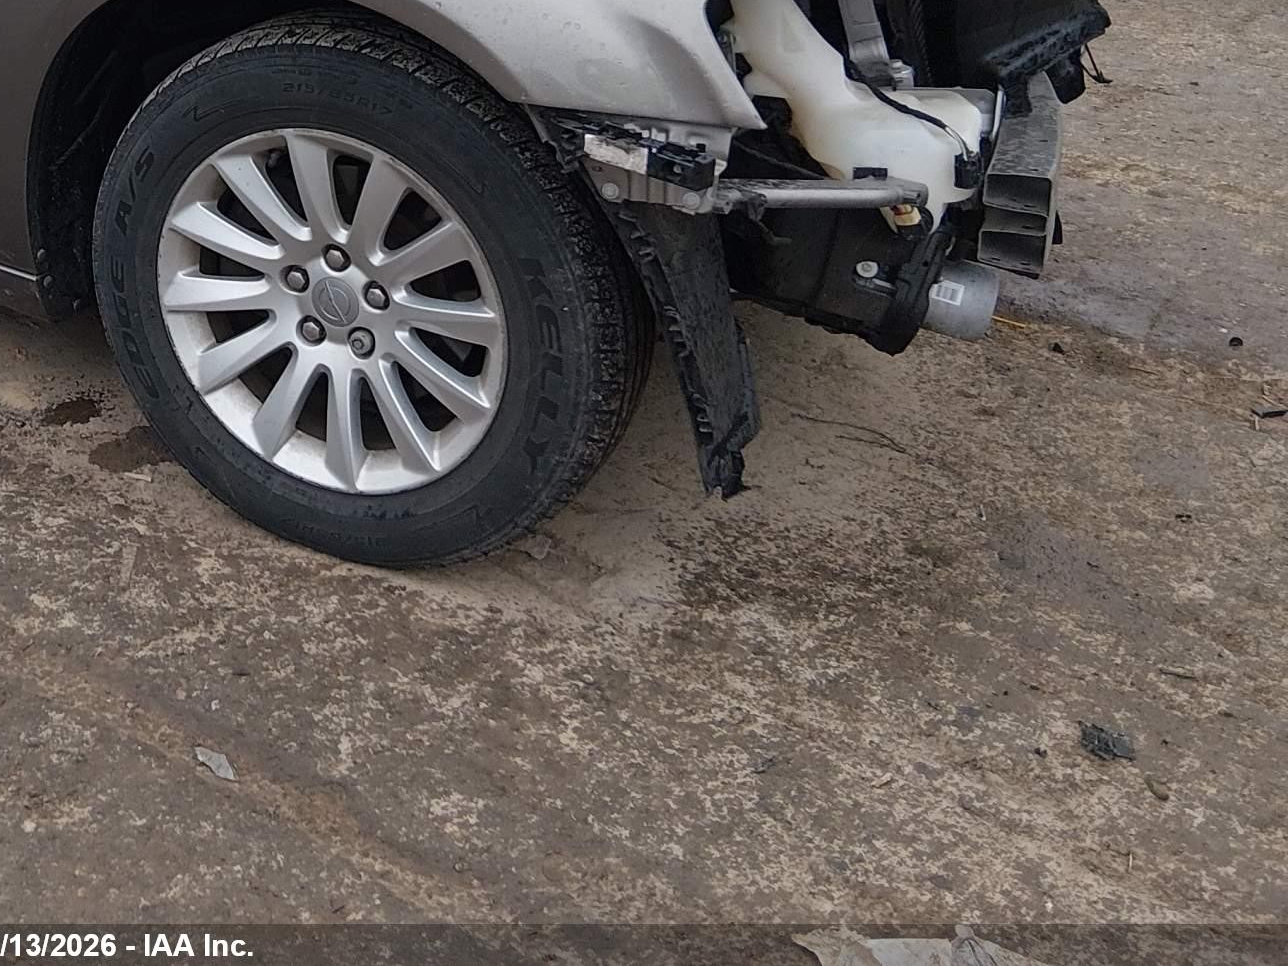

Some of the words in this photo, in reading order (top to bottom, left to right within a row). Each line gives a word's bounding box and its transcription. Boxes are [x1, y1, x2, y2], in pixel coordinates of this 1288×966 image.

[115, 145, 155, 237] A/S
[110, 253, 159, 399] EDGE
[515, 257, 564, 474] KELLY
